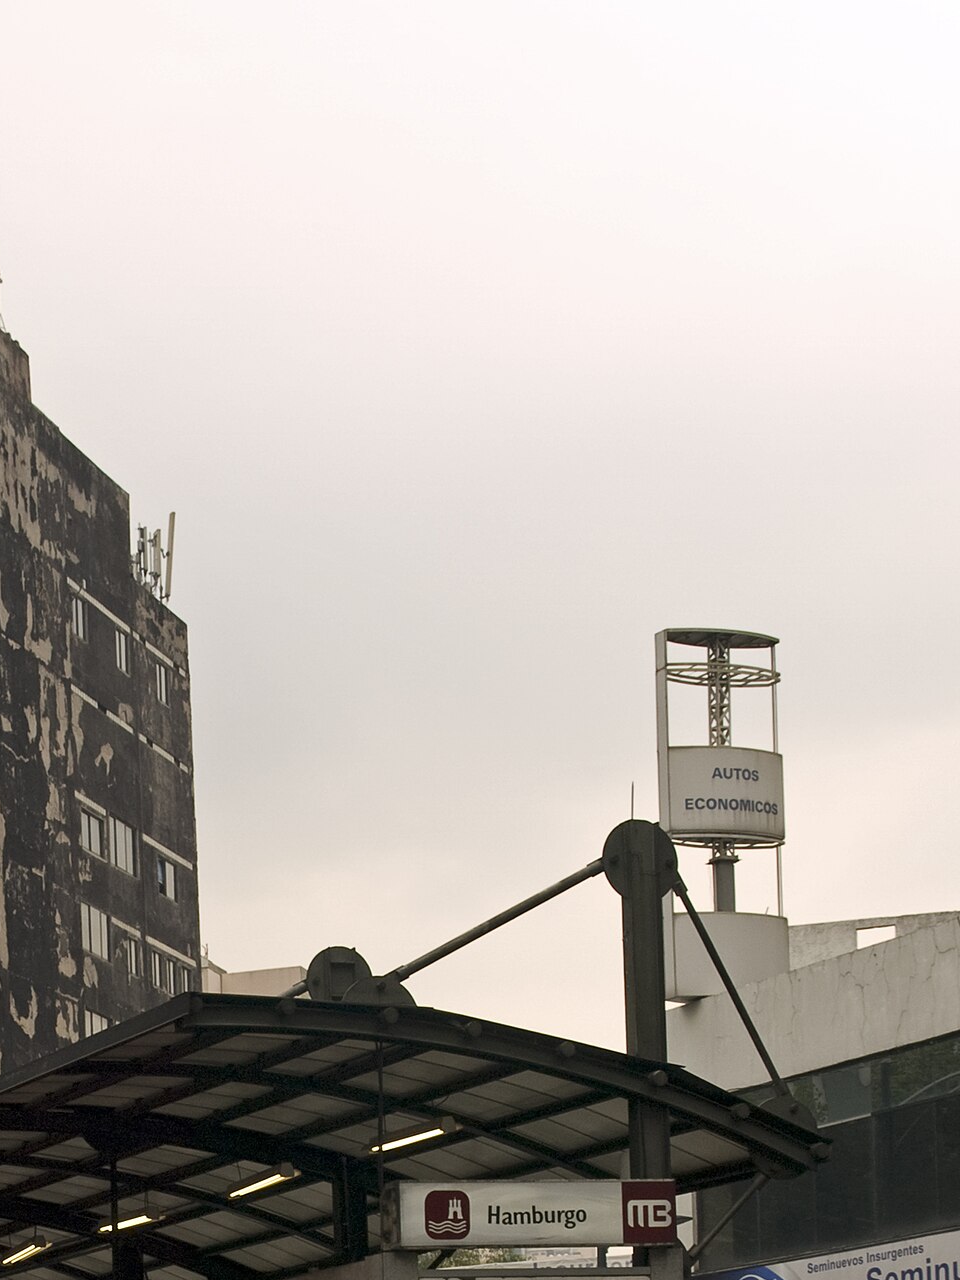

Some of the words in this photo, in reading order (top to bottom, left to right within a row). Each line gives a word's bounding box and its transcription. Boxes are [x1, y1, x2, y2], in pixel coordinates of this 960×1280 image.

[712, 767, 759, 782] AUTOS
[685, 797, 778, 815] ECONOMICOS
[487, 1205, 587, 1230] Hamburgo
[807, 1254, 864, 1274] Seminuevos
[866, 1244, 924, 1263] Insurgentes
